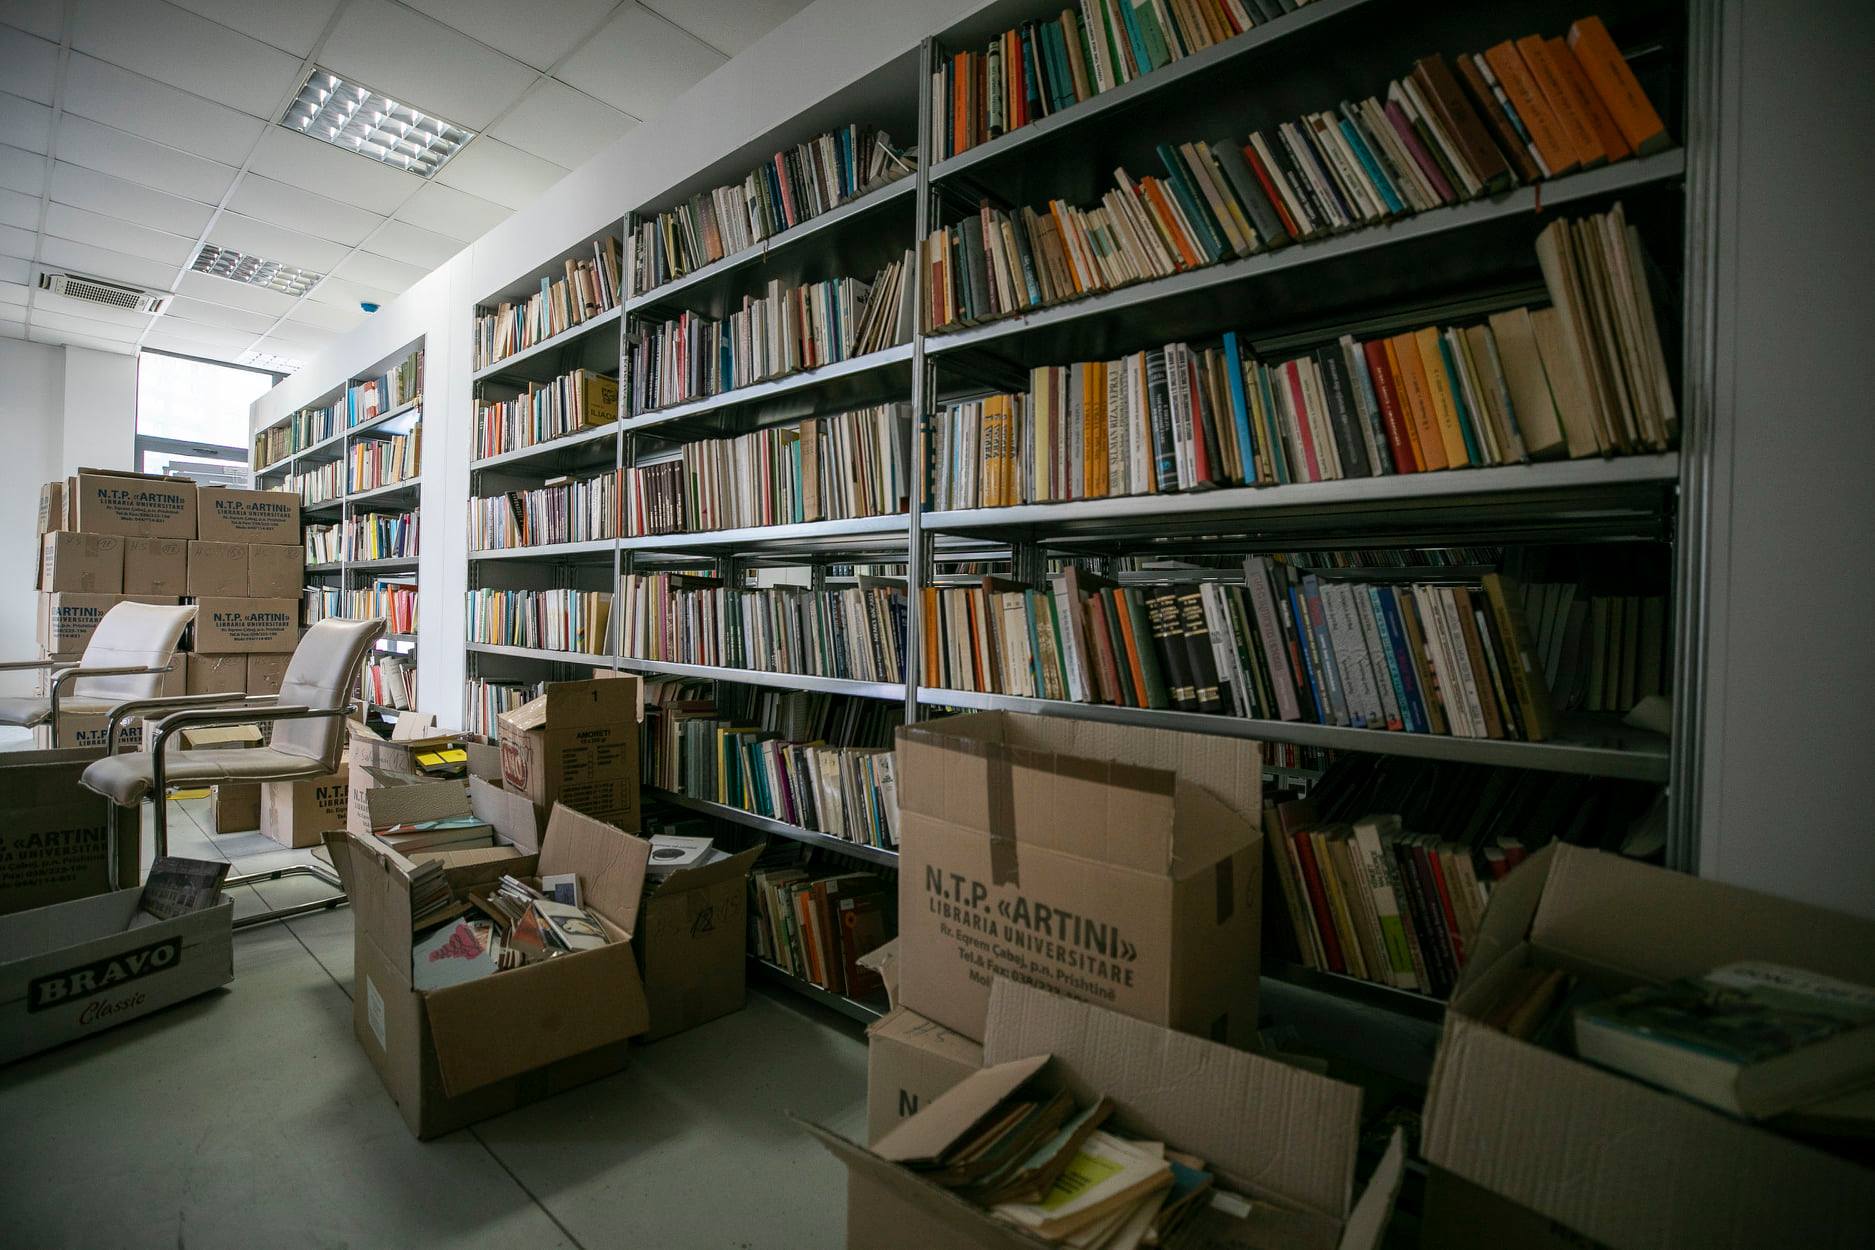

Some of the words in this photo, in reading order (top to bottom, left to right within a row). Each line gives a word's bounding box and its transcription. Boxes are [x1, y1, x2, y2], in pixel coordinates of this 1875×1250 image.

[97, 489, 130, 500] N.T.P.
[215, 500, 244, 510] N.T.P.
[213, 613, 242, 622] N.T.P.
[76, 729, 108, 740] N.T.P
[13, 826, 107, 849] «ARTINI
[925, 864, 991, 914] N.T.P.
[998, 896, 1138, 963] «ARTINI»
[930, 897, 998, 938] LIBRARIA
[1003, 925, 1134, 988] UNIVERSITARE
[956, 928, 990, 952] Eqrem
[39, 945, 175, 1005] BRAVO
[79, 991, 146, 1025] Classic
